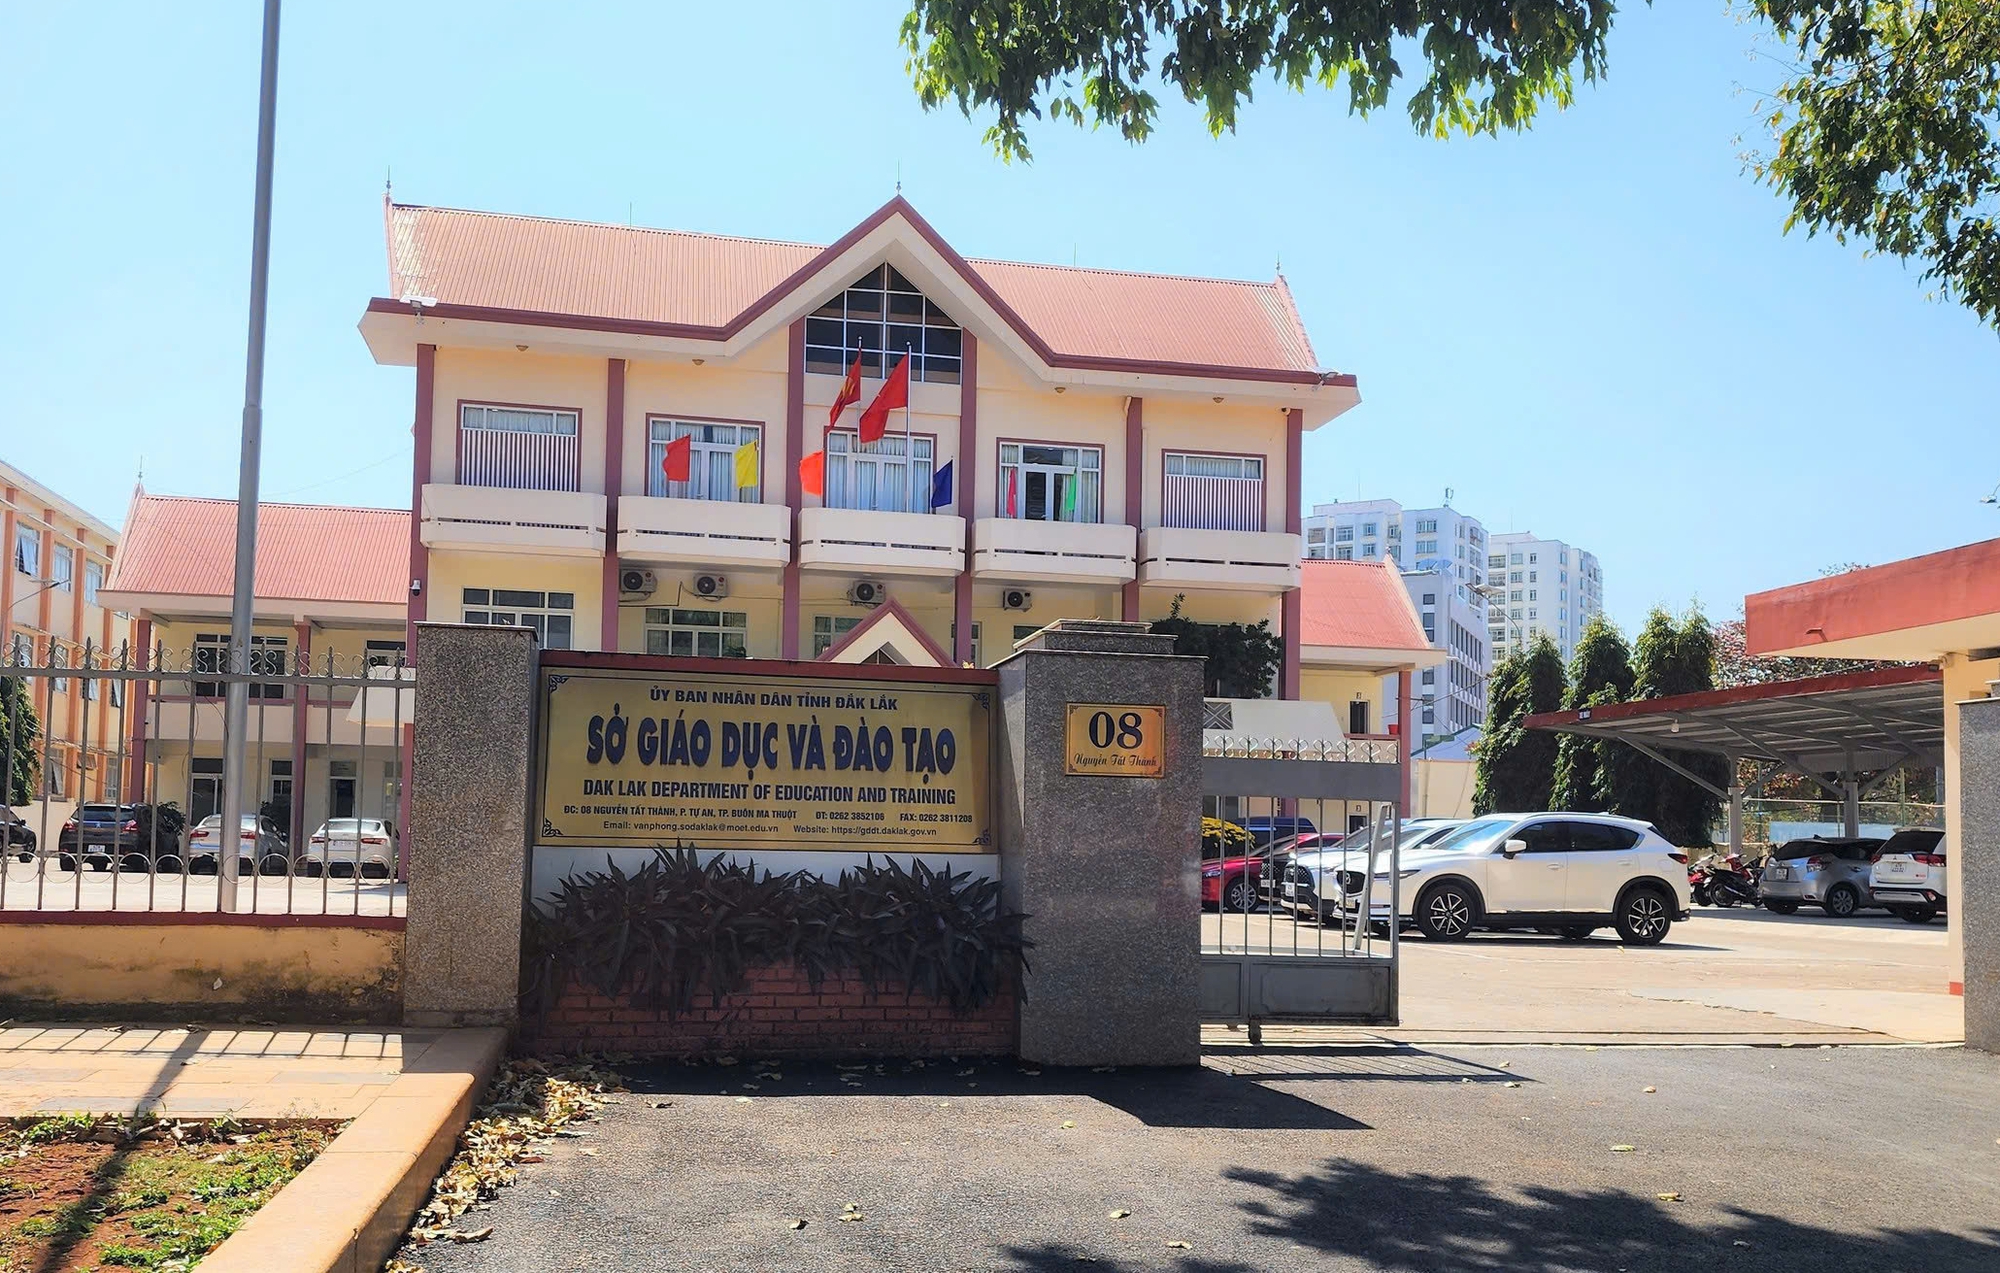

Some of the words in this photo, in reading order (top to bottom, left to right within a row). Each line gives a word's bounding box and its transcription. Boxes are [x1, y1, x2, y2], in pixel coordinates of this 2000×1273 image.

[651, 685, 670, 701] ỦY
[675, 690, 707, 703] BAN
[712, 690, 756, 705] NHÂN
[760, 692, 792, 707] DÂN
[797, 692, 831, 708] TỈNH
[835, 693, 865, 710] ĐẮK
[870, 694, 898, 711] LẮK
[1089, 711, 1143, 750] 08
[586, 703, 629, 765] SỞ
[637, 709, 711, 768] GIÁO
[721, 720, 778, 780] DỤC
[787, 715, 826, 771] VÀ
[833, 716, 894, 773] ĐÀO
[902, 727, 956, 785] TẠO
[583, 779, 614, 796] DAK
[618, 780, 647, 797] LAK
[651, 781, 749, 800] DEPARTMENT
[753, 784, 771, 800] OF
[775, 785, 853, 803] EDUCATION
[858, 786, 886, 804] AND
[890, 788, 956, 805] TRAINING
[564, 805, 578, 814] ĐC:
[580, 806, 592, 815] 08
[680, 808, 687, 817] P.
[701, 808, 716, 818] AN,
[718, 809, 730, 818] TP.
[756, 810, 770, 819] MA
[829, 811, 850, 820] 0262
[900, 813, 917, 822] FAX:
[918, 813, 938, 822] 0262
[603, 820, 631, 830] Email:
[793, 824, 829, 834] Website:
